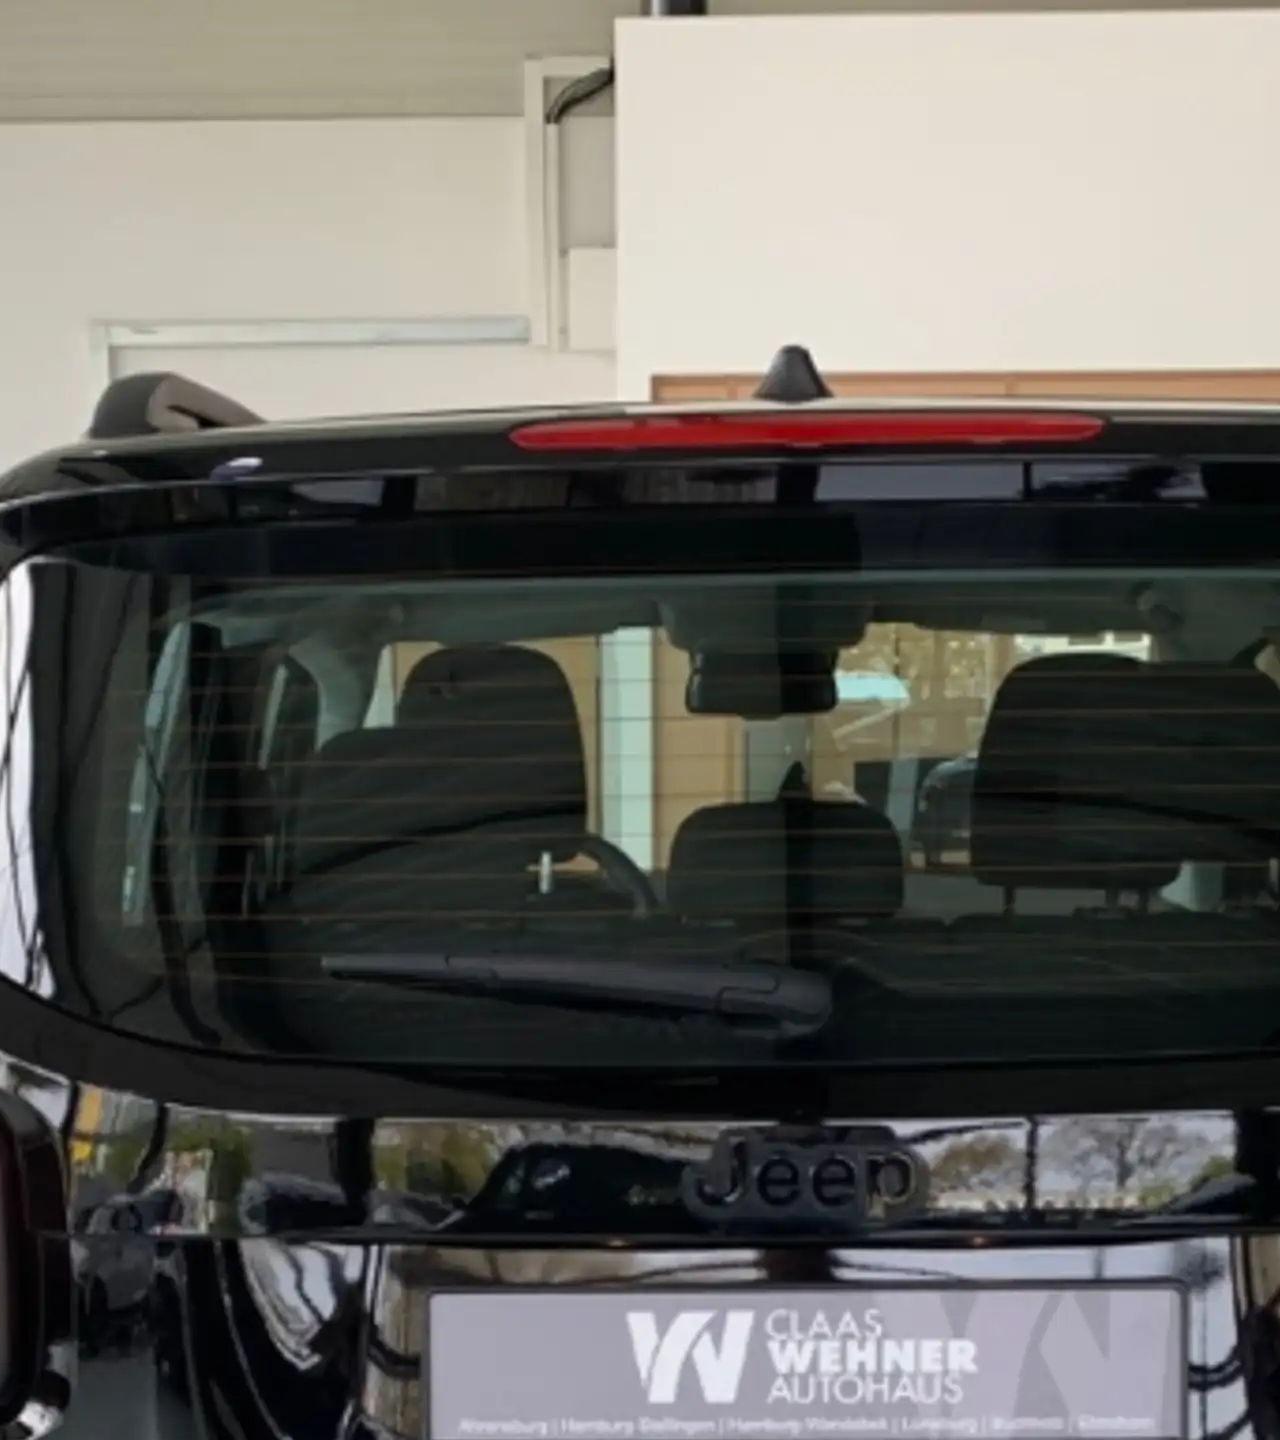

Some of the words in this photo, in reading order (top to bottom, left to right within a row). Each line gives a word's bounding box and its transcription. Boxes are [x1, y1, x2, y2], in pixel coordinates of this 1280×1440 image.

[690, 1137, 917, 1218] Jeep
[765, 1309, 882, 1339] CLAAS
[767, 1339, 977, 1374] WEHNER
[768, 1374, 963, 1403] AUTOHAUS
